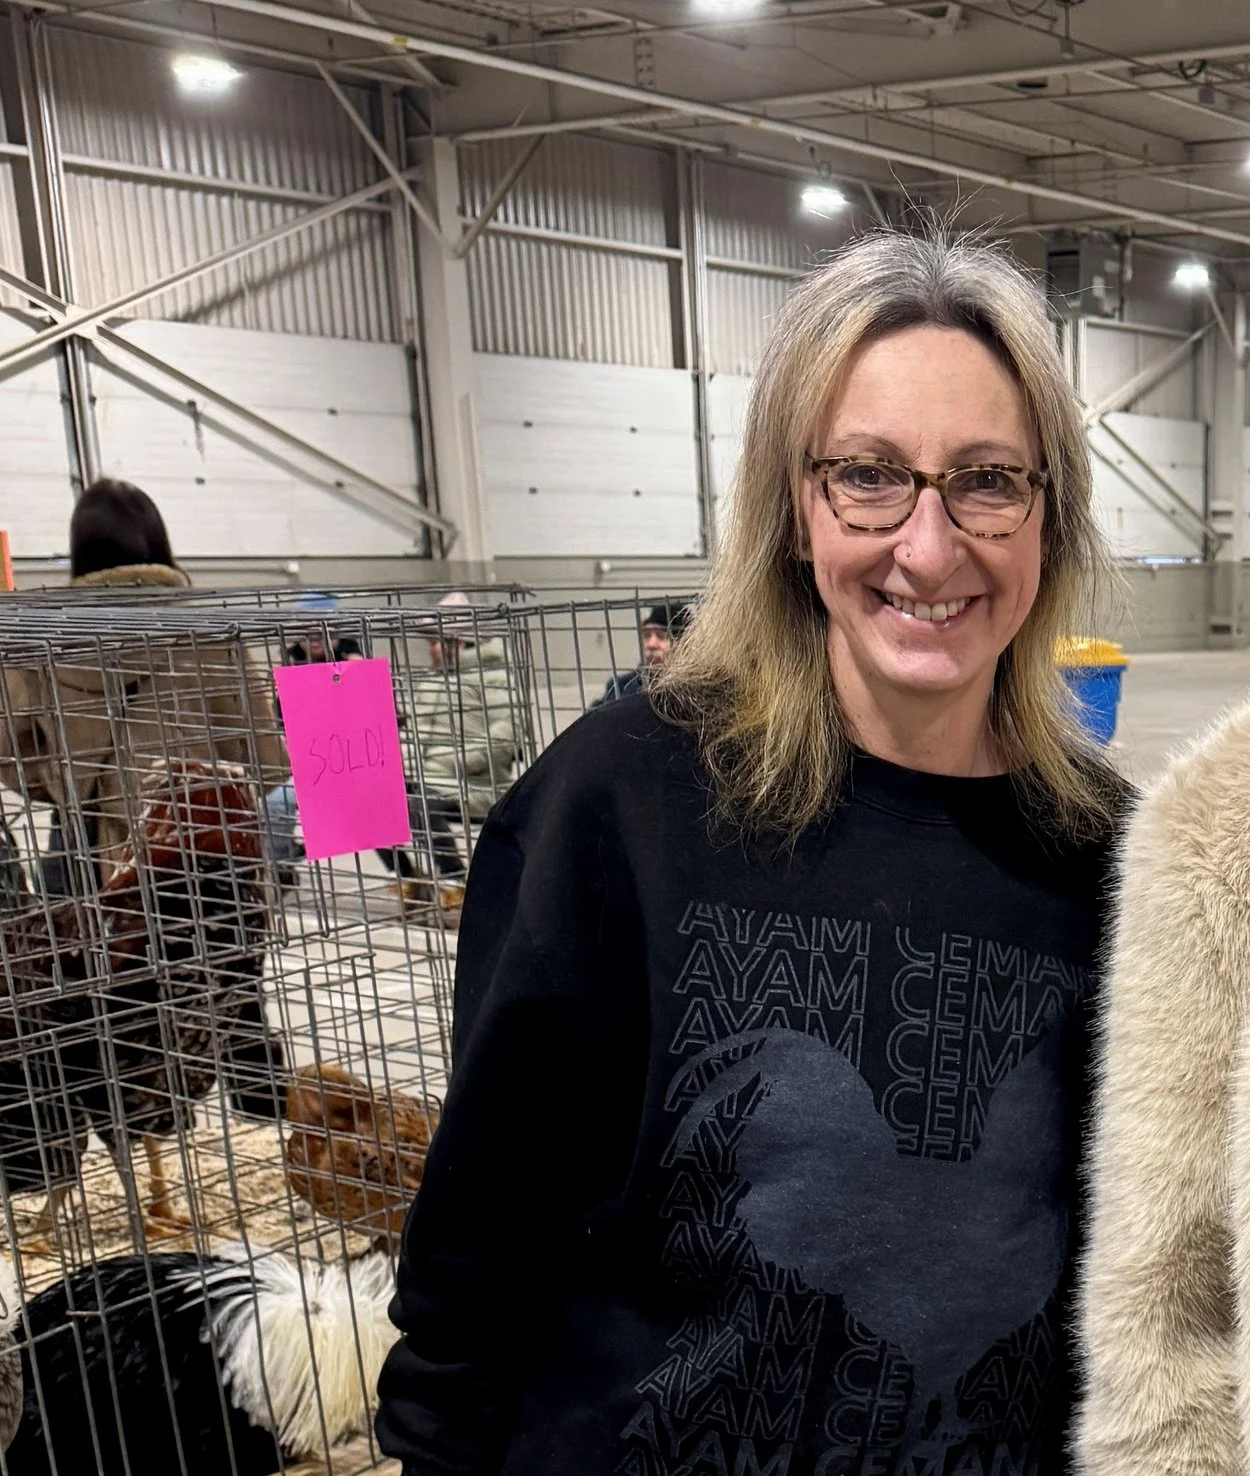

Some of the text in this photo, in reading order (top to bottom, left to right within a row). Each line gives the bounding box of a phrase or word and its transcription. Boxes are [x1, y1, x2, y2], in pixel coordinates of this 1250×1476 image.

[309, 724, 385, 786] SOLD!
[676, 900, 871, 957] AYAM
[671, 938, 869, 1013] AYAM
[634, 1353, 806, 1440] AYAM
